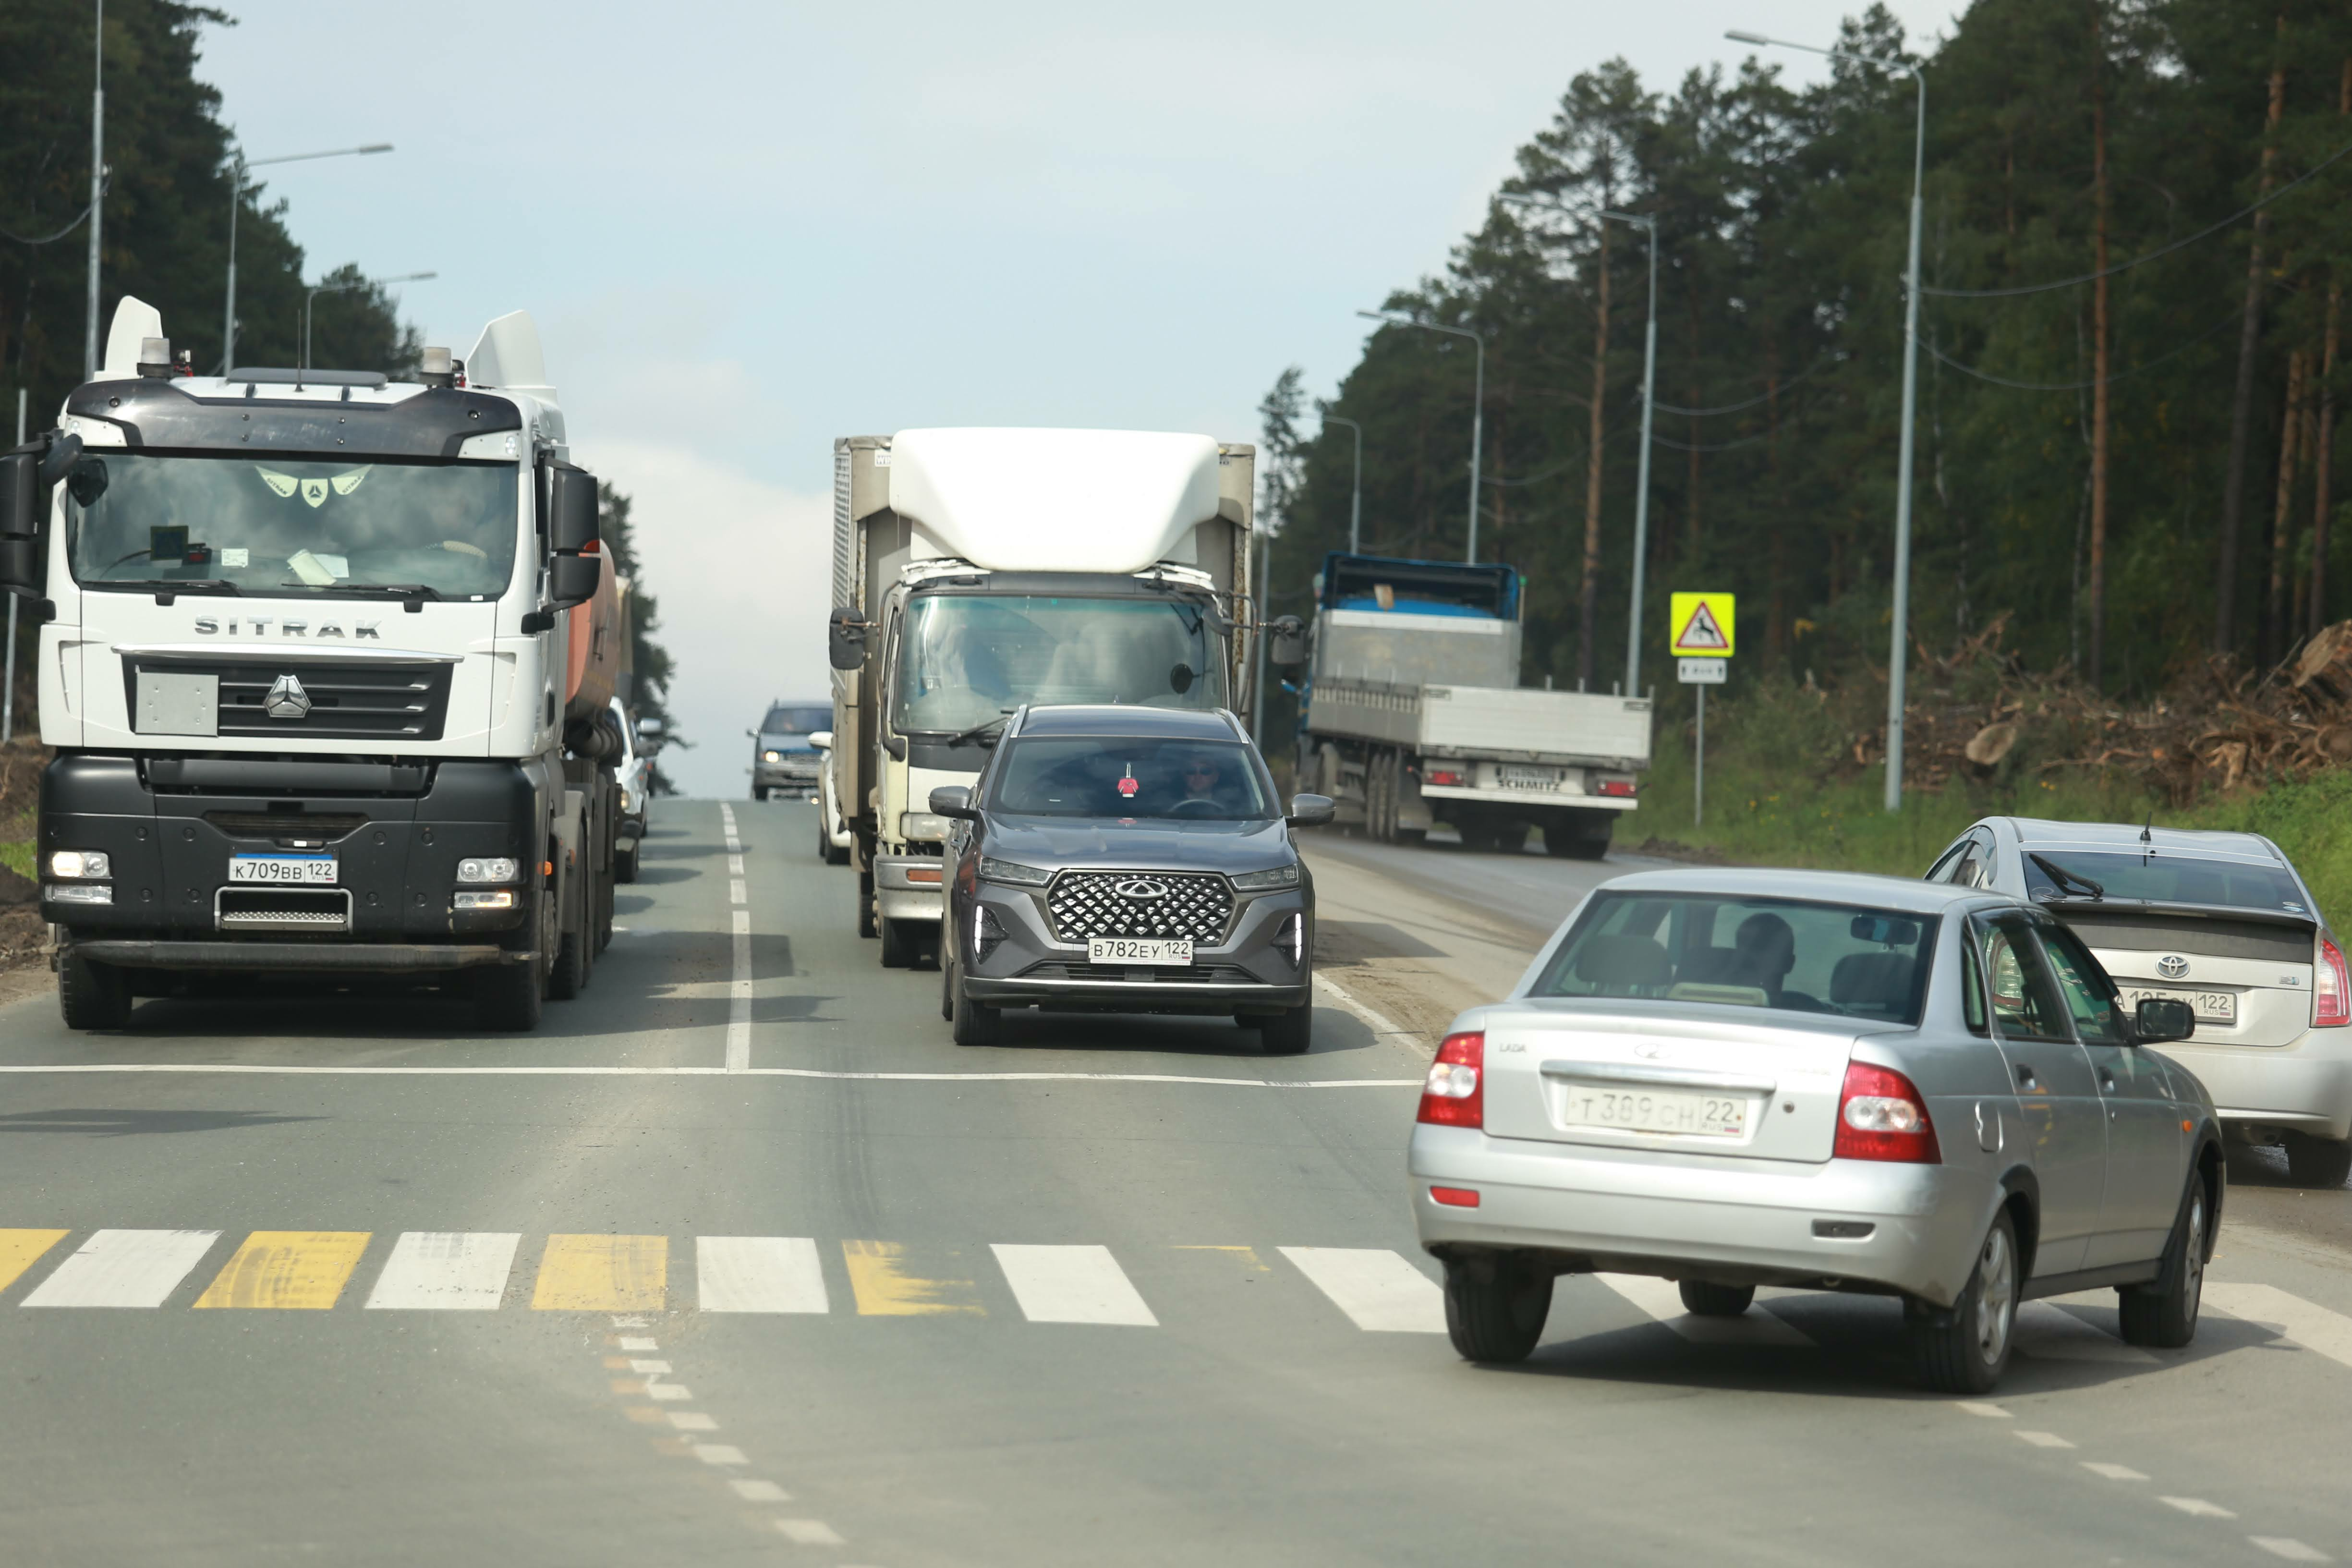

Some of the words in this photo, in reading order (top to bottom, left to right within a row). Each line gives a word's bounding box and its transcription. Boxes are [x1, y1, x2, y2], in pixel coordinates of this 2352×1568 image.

[195, 615, 382, 639] SITRAK
[307, 863, 332, 876] 122
[1164, 942, 1188, 955] 122
[2198, 994, 2228, 1009] 122
[1705, 1100, 1734, 1123] 22
